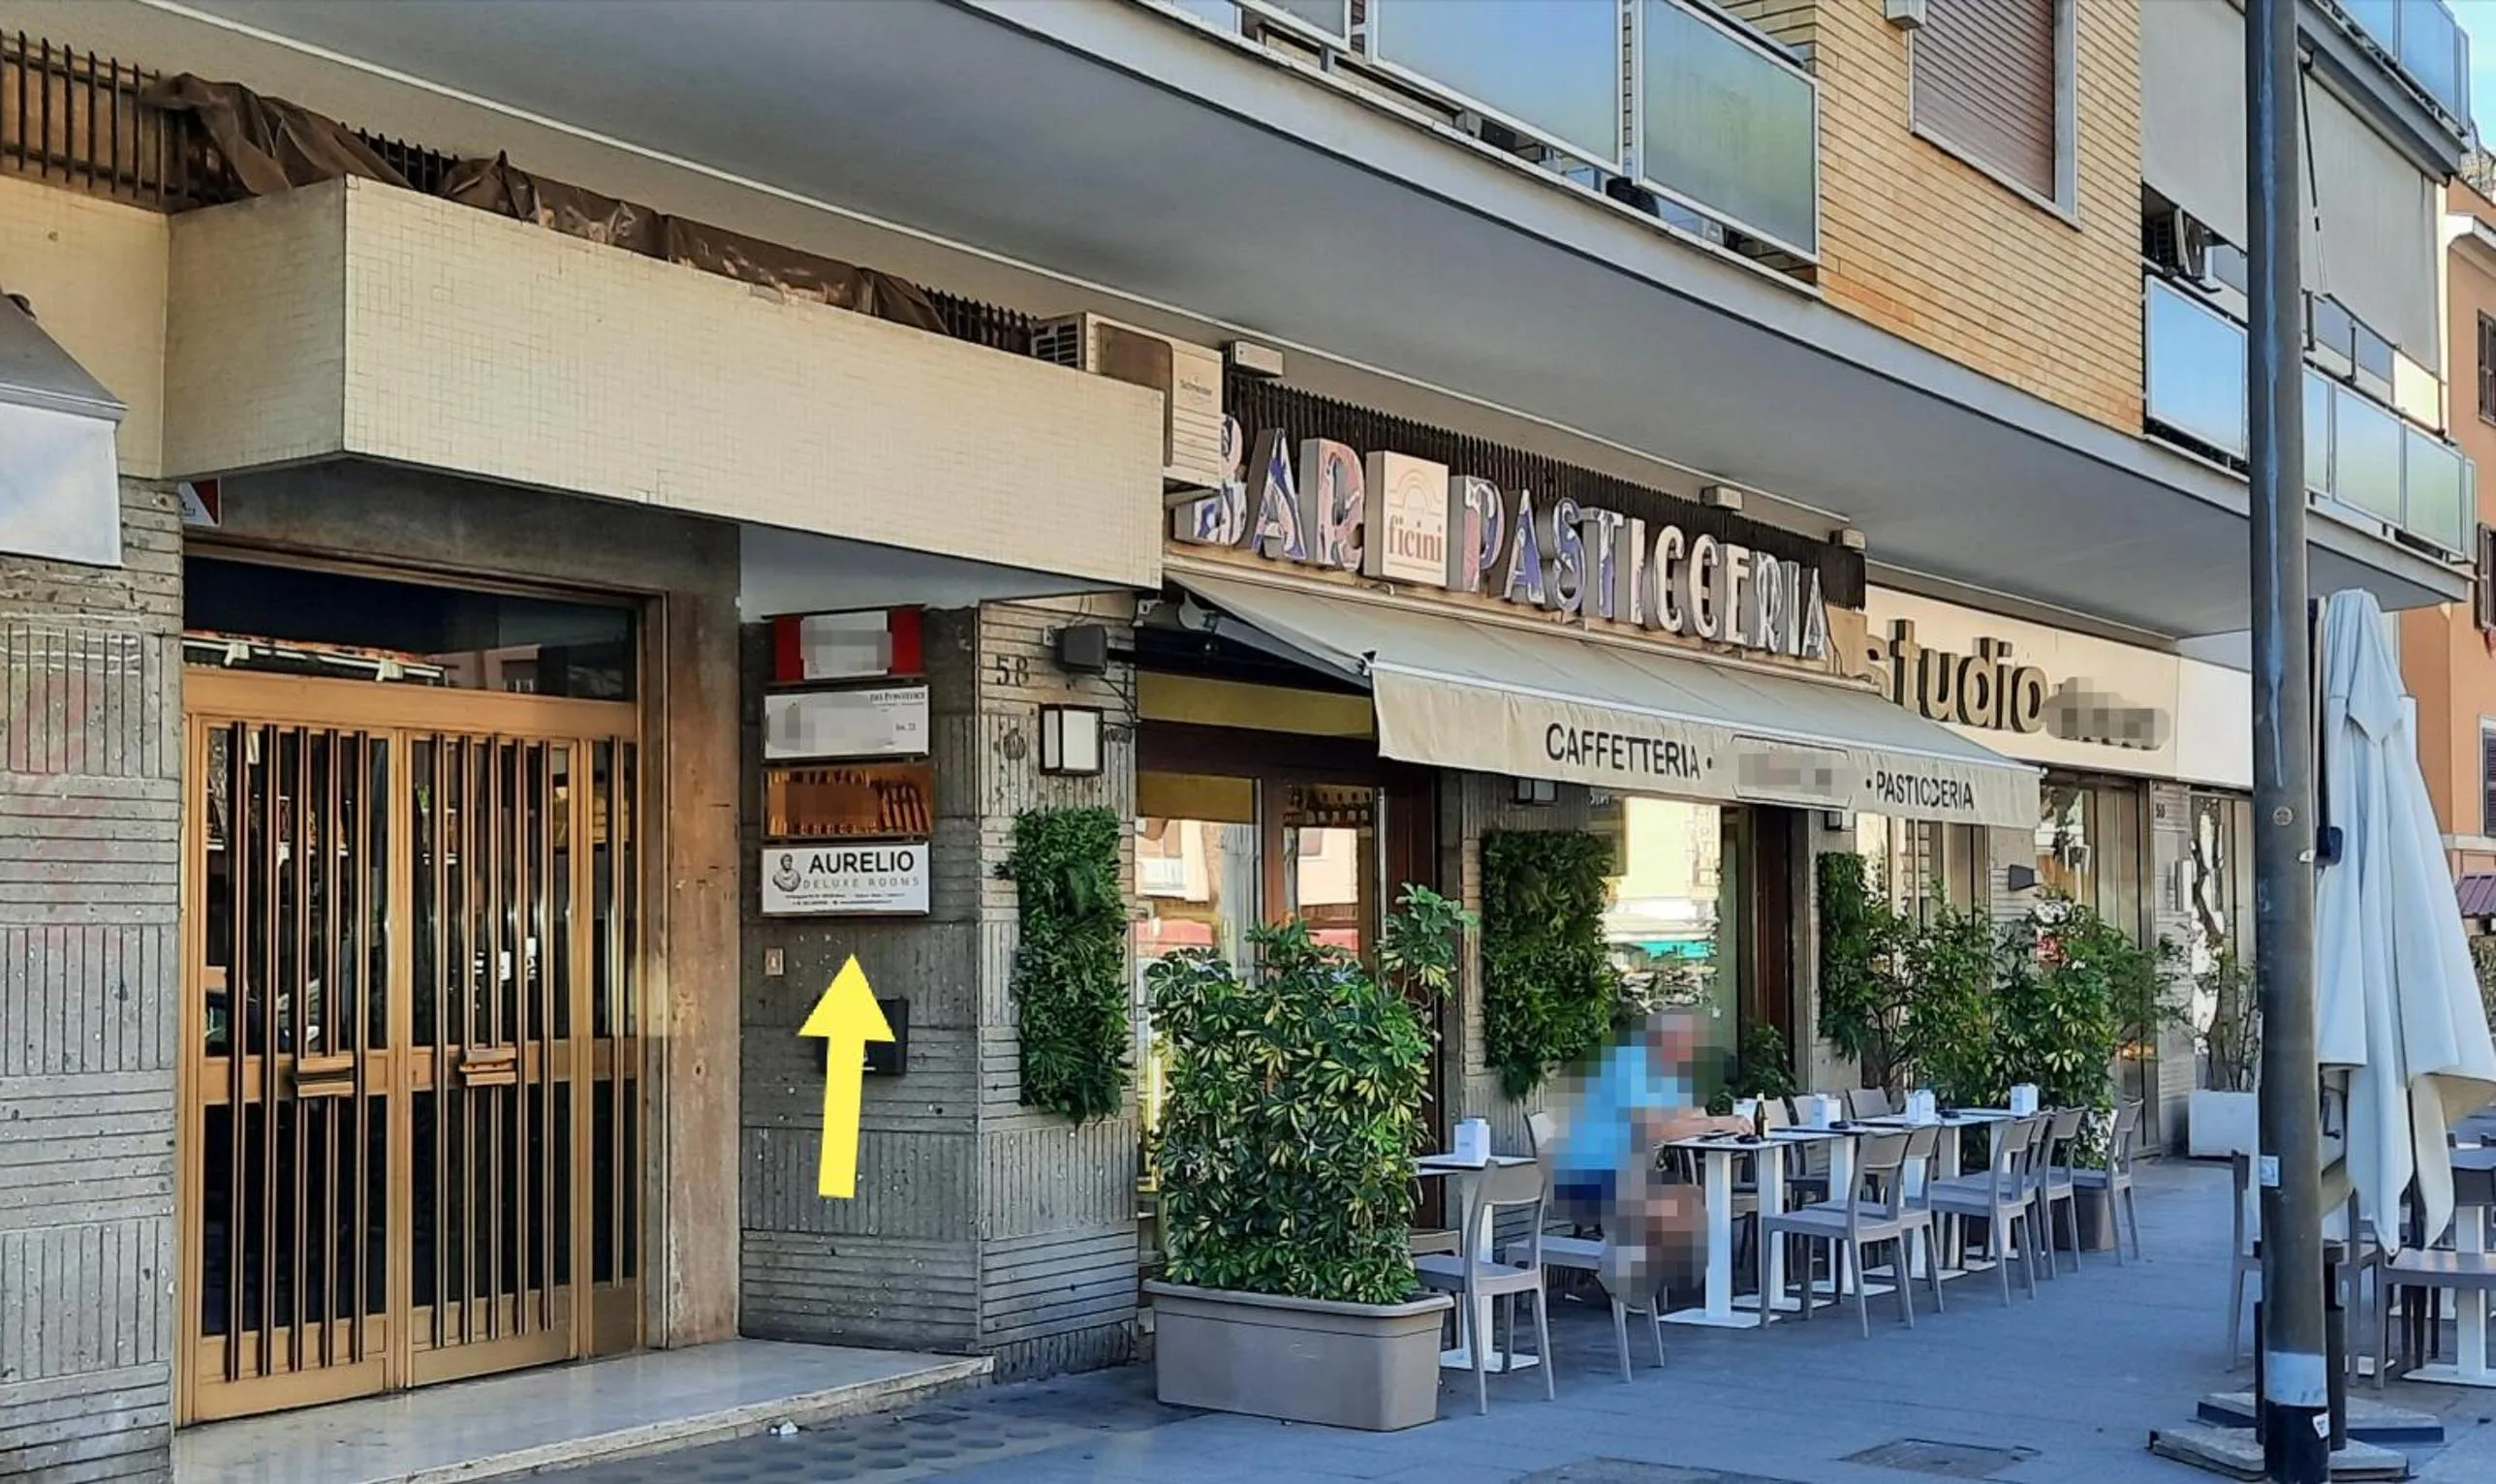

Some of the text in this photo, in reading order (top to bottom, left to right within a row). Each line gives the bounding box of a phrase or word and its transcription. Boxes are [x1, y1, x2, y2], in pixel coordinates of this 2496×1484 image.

[1182, 414, 1364, 572] BAR
[1388, 514, 1443, 562] ficini
[1462, 475, 1827, 661] PASTICCERIA
[996, 655, 1029, 687] 58
[1864, 619, 2048, 733] studio
[1545, 723, 1700, 780] CAFFETTERIA
[802, 876, 920, 889] DELUXE ROOMS
[808, 850, 915, 874] AURELIO
